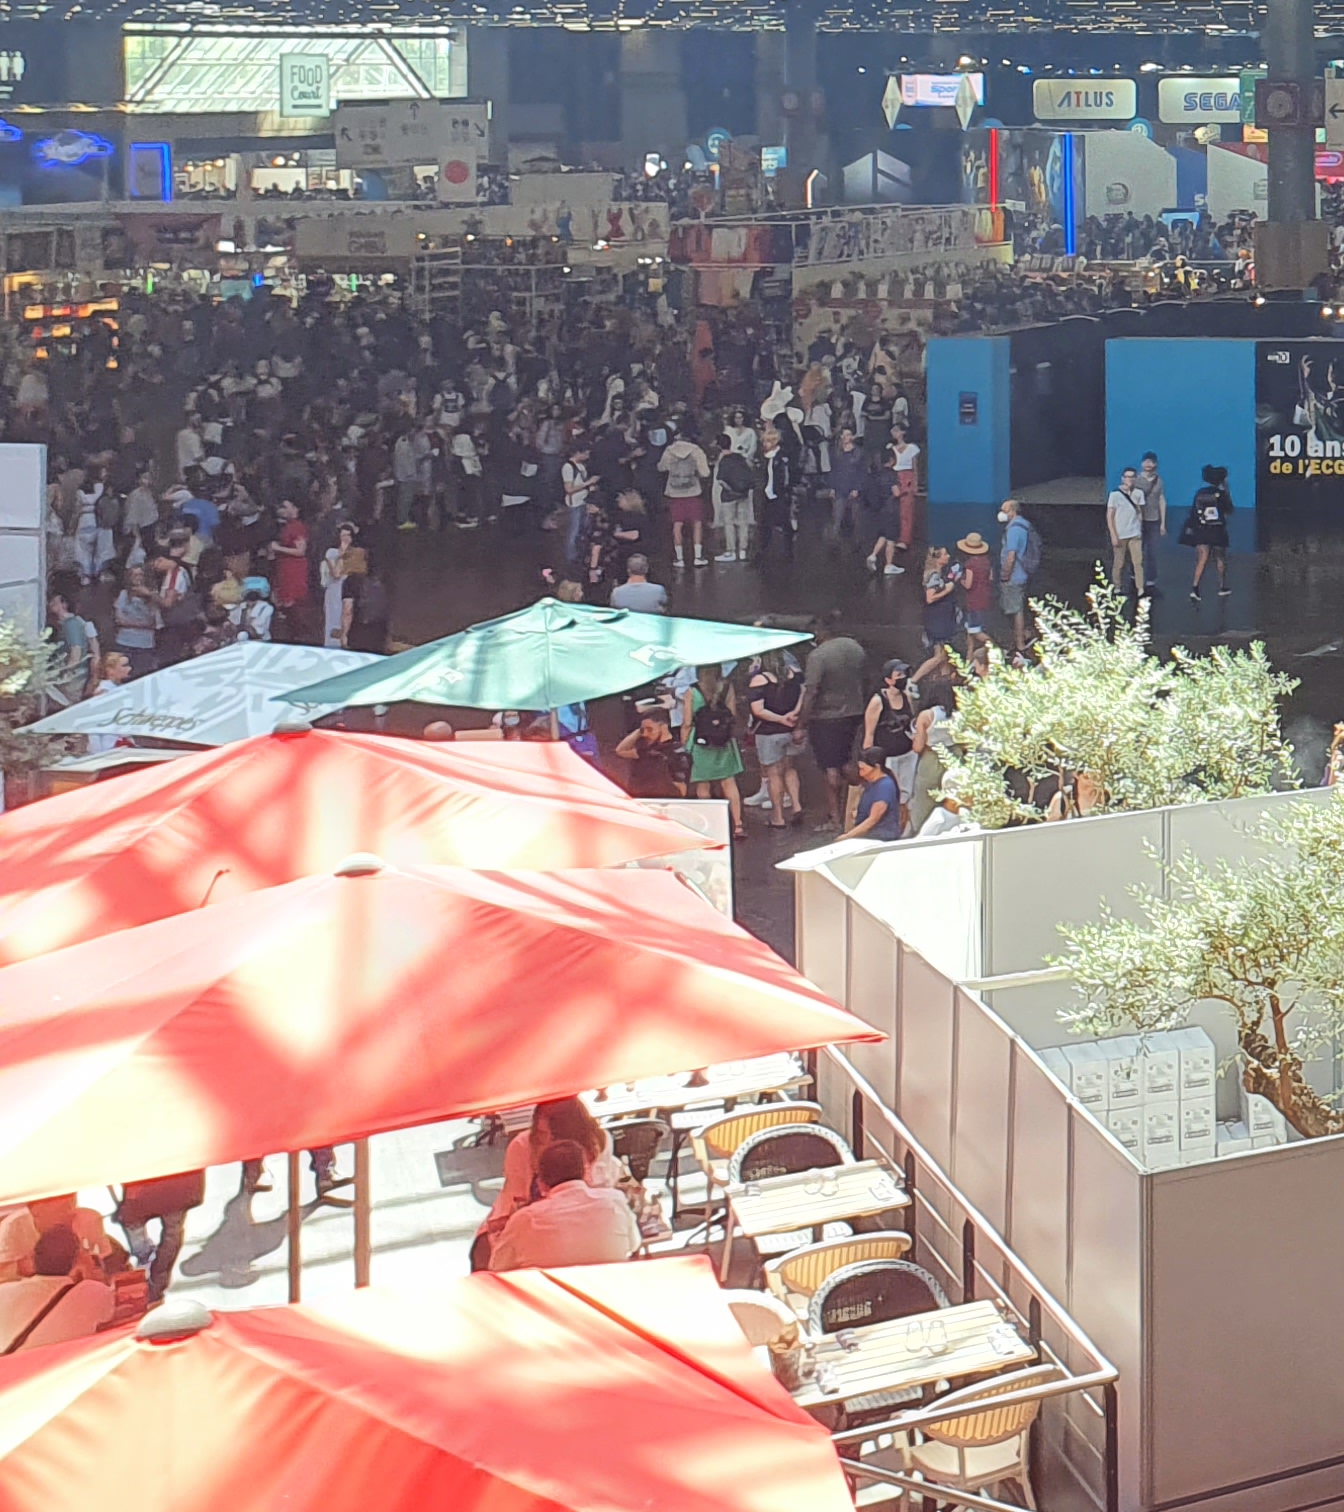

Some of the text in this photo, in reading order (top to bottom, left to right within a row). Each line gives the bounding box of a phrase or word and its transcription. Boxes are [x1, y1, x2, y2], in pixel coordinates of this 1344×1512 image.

[290, 65, 322, 86] FOOD
[290, 86, 322, 100] Court
[1057, 91, 1114, 108] ATLUS
[1183, 92, 1242, 112] SEGA
[1268, 434, 1301, 457] 10
[1270, 459, 1293, 474] de
